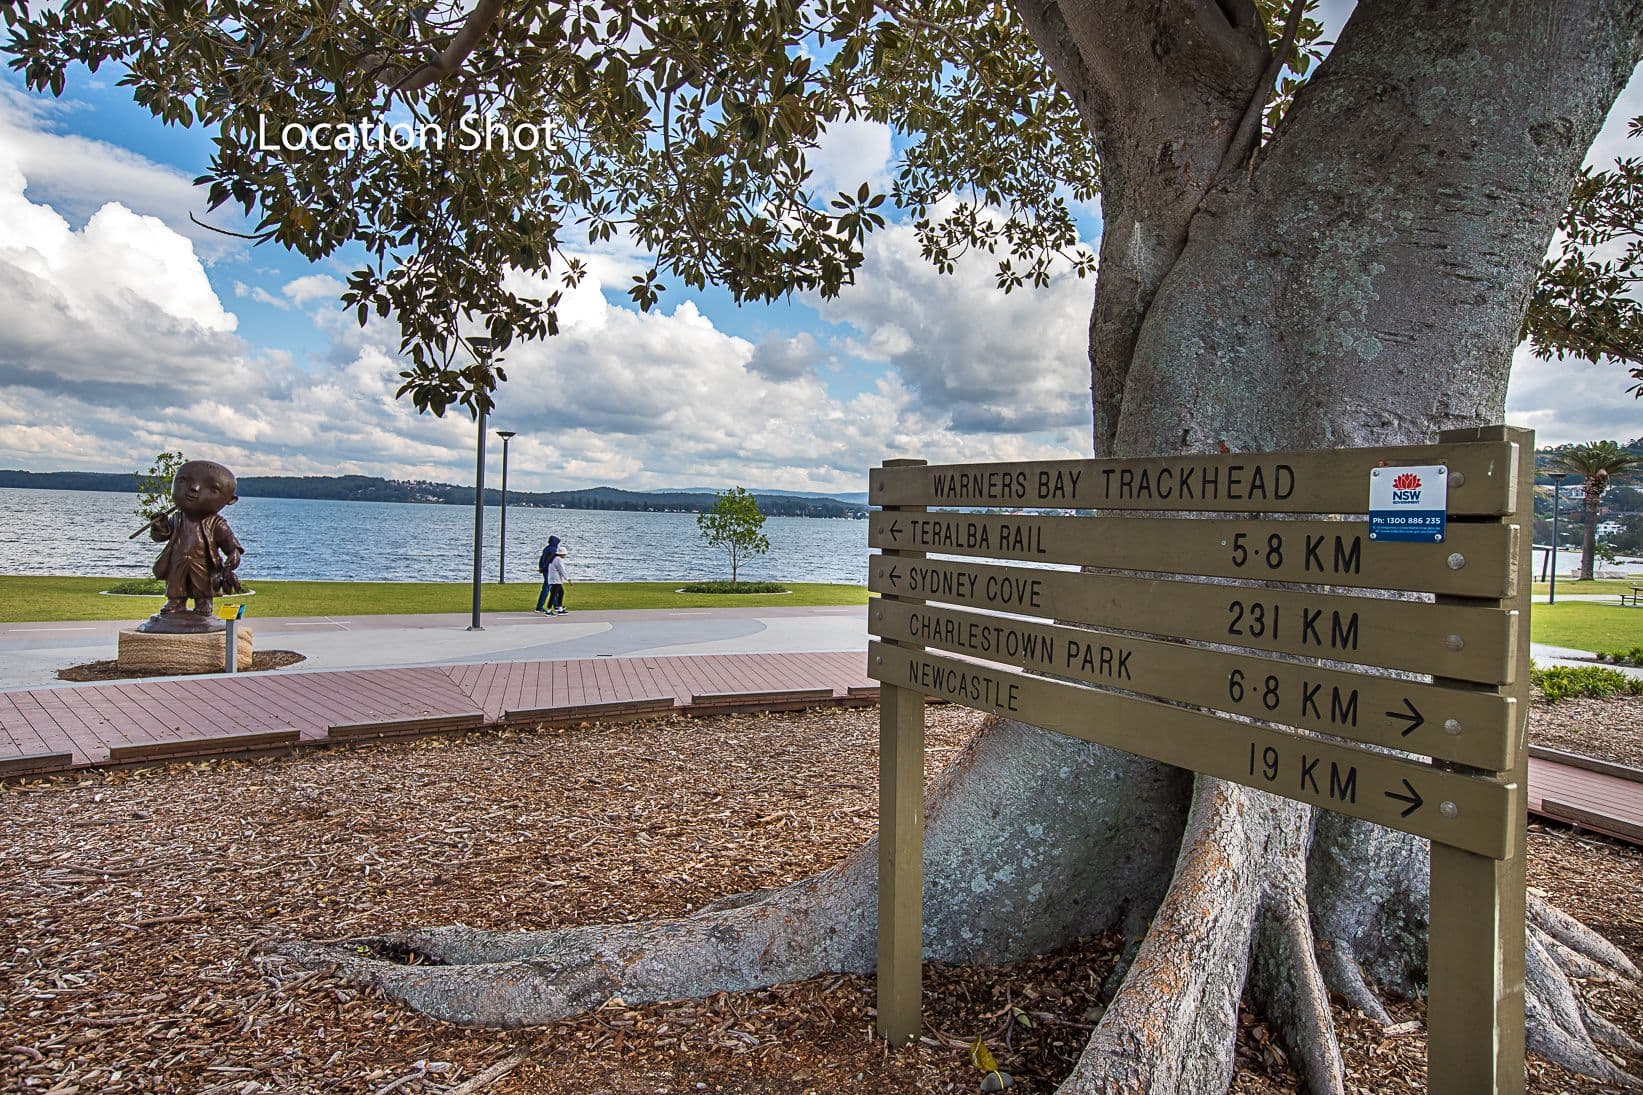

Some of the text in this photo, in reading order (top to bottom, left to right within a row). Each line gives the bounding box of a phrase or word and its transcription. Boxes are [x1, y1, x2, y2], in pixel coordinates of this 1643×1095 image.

[933, 464, 1296, 500] WARNERS BAY TRACKHEAD
[1392, 491, 1421, 500] NSW
[910, 520, 1047, 553] TERALBA RAIL
[1304, 535, 1362, 575] KM
[909, 567, 1042, 607] SYDNEY COVE
[909, 613, 1132, 680] CHARLESTOWN PARK
[1227, 600, 1359, 650] 231 KM
[909, 659, 1020, 712] NEWCASTLE
[1302, 681, 1359, 727] KM
[1249, 742, 1358, 804] 19 KM
